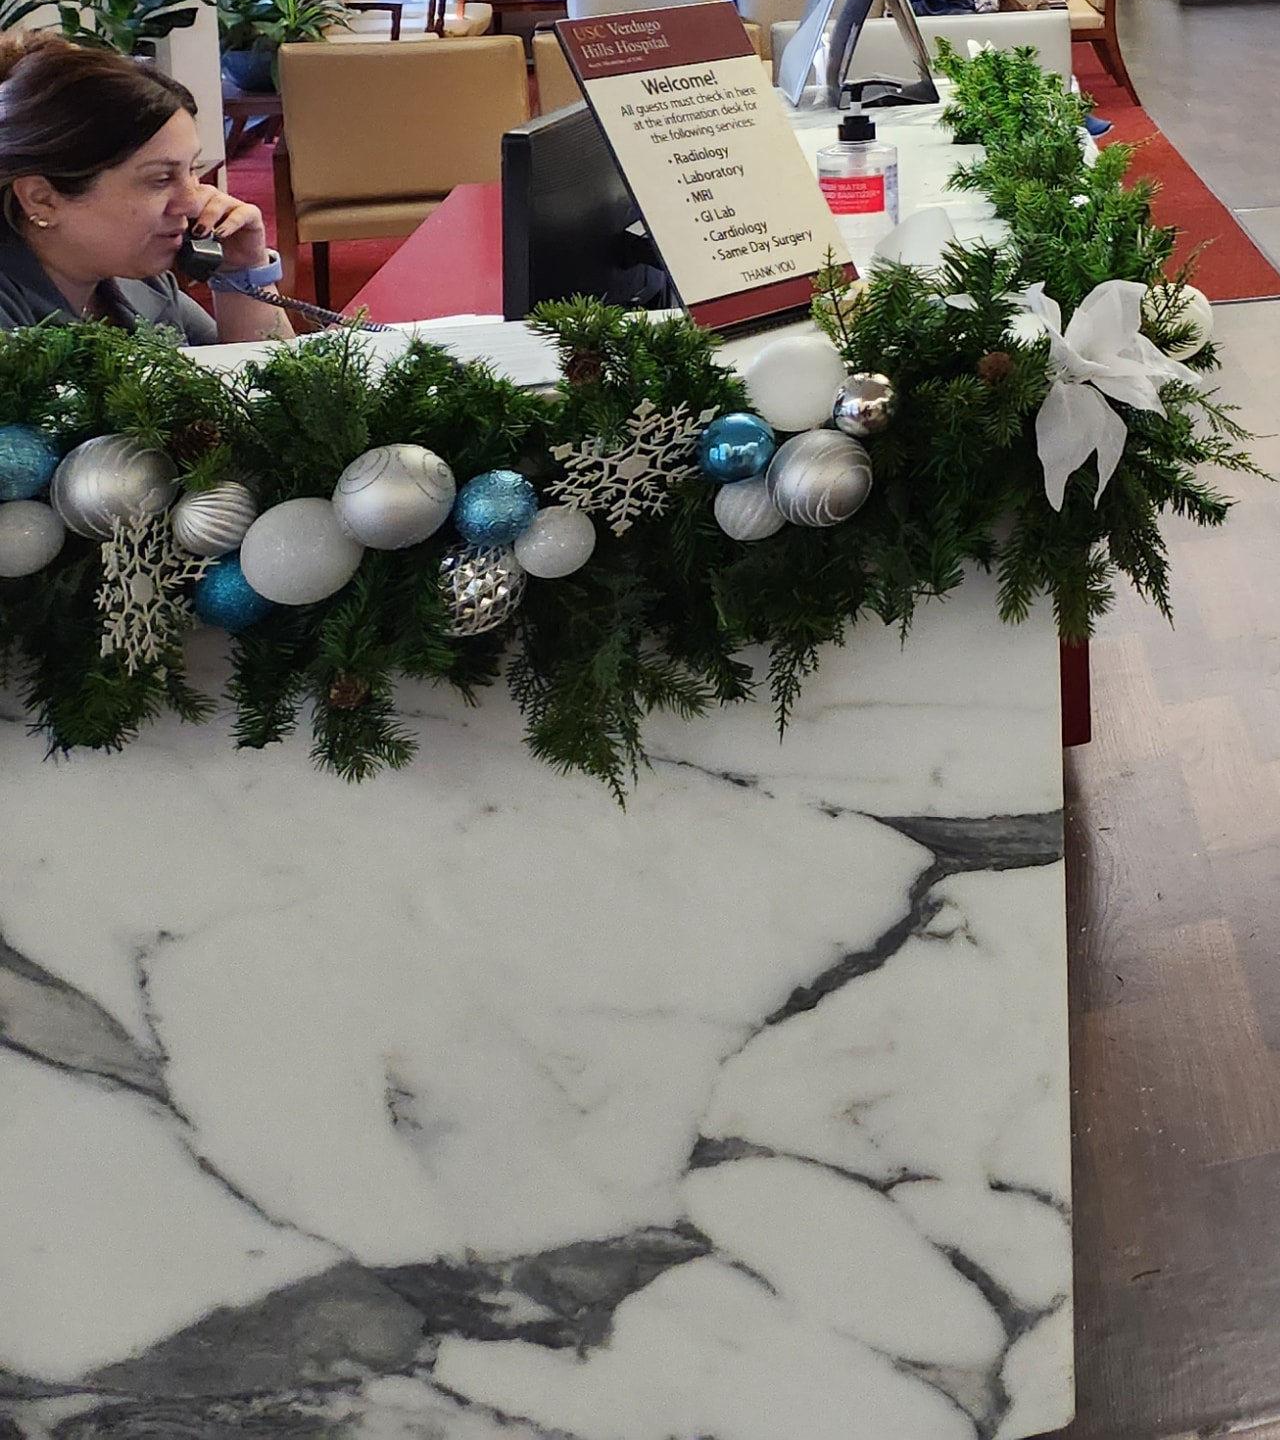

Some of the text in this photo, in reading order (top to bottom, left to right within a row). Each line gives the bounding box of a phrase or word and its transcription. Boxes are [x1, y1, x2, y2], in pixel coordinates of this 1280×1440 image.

[572, 19, 661, 42] USC Verdugo
[580, 34, 670, 59] Hills Hospital
[641, 69, 718, 96] Welcome!
[621, 86, 757, 117] All guests must check in here
[633, 100, 757, 131] at the information desk for
[650, 118, 757, 144] the following services:
[673, 146, 729, 166] Radiology
[682, 164, 744, 185] Laboratory
[690, 188, 714, 204] MRI
[700, 205, 736, 223] GI Lab
[709, 221, 768, 242] Cardiology
[717, 229, 813, 261] Same Day Surgery
[740, 259, 796, 282] THANK YOU
